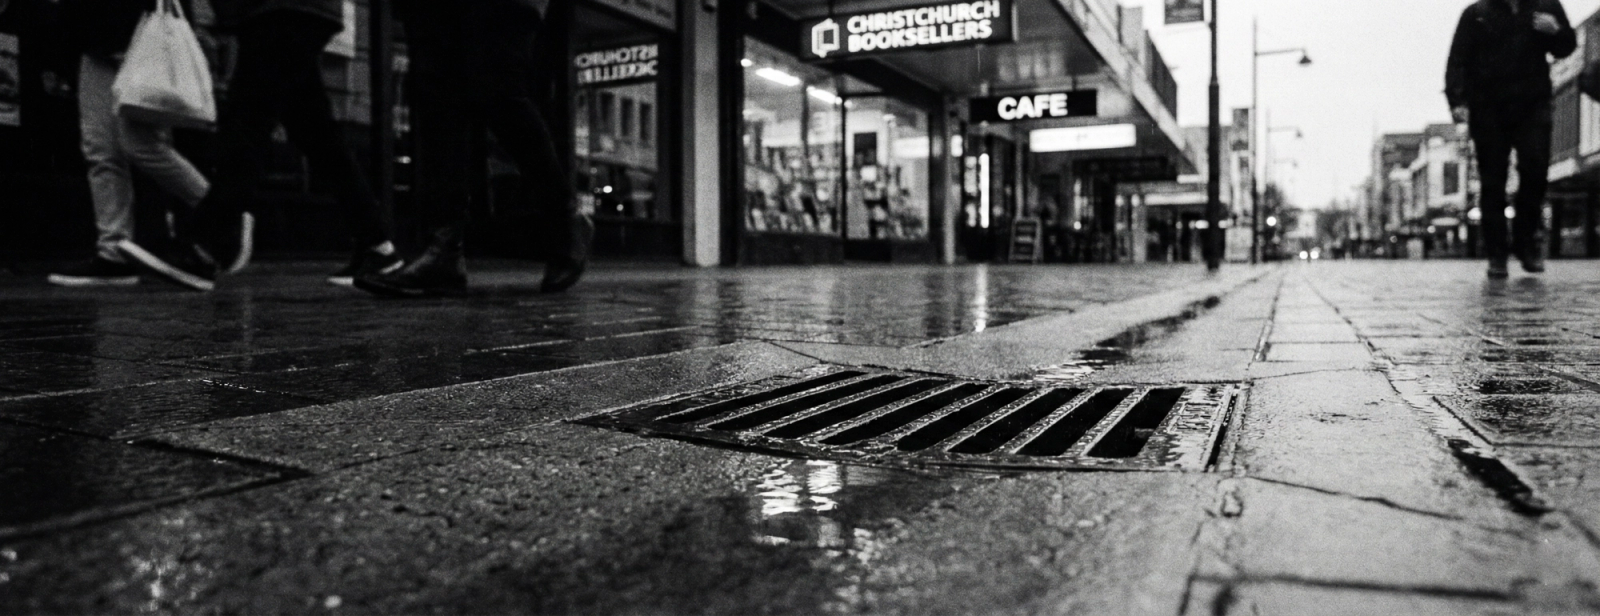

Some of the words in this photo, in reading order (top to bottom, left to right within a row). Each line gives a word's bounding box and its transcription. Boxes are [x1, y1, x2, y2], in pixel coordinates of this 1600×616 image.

[847, 0, 1000, 34] CHRISTCHURCH
[848, 19, 992, 52] BOOKSELLERS
[997, 93, 1068, 120] CAFE
